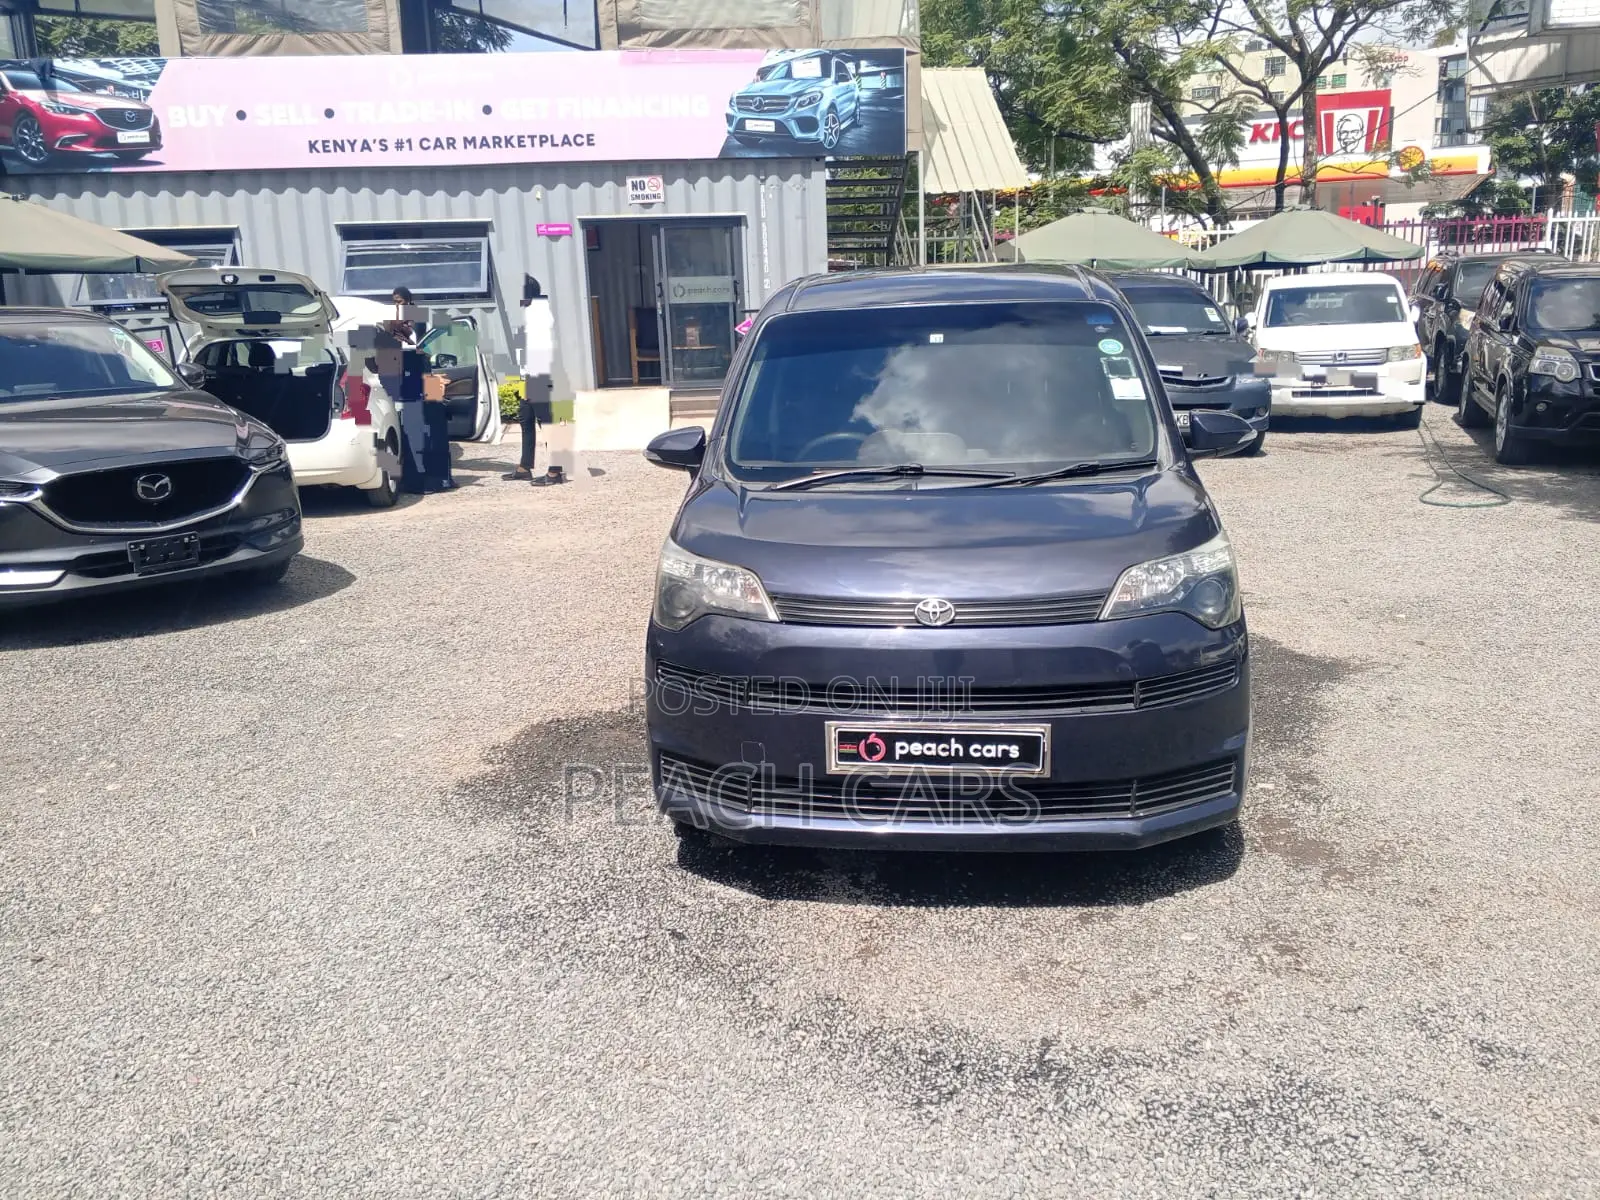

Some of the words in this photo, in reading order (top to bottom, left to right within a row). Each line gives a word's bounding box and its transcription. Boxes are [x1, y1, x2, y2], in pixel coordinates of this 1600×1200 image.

[167, 104, 229, 128] BUY
[254, 103, 319, 127] SELL
[341, 100, 476, 124] TRADE-IN
[500, 99, 549, 122] GET
[555, 95, 710, 119] FINANCING
[308, 138, 389, 154] KENYA'S
[394, 137, 413, 152] #1
[419, 136, 457, 151] CAR
[462, 133, 596, 150] MARKETPLACE
[631, 180, 646, 191] NO
[630, 193, 662, 201] SMOKING
[894, 738, 964, 760] peach
[969, 743, 1020, 759] cars
